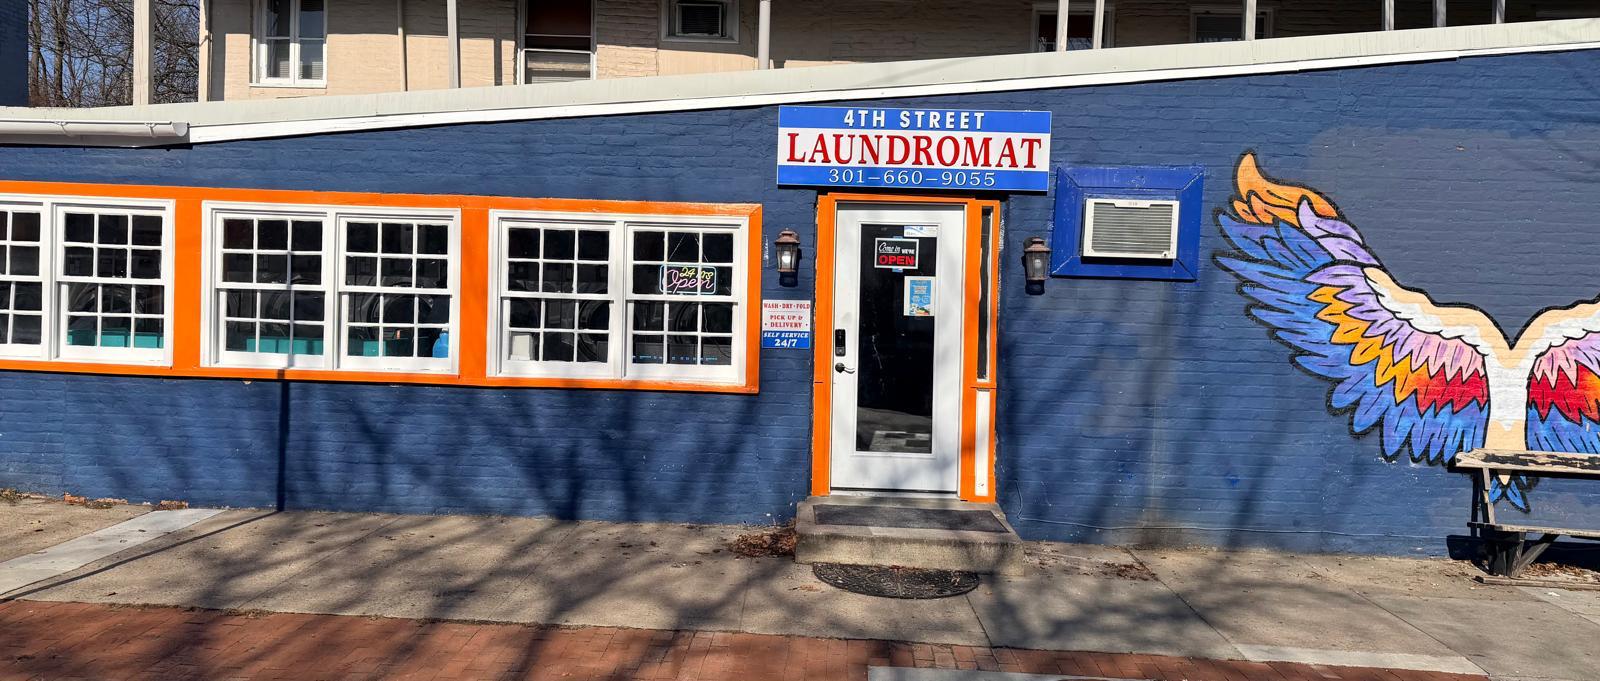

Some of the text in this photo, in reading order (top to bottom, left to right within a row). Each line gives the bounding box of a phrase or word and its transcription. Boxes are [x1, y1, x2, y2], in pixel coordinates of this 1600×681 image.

[843, 109, 985, 130] 4TH STREET
[786, 132, 1042, 169] LAUNDROMAT
[828, 168, 996, 187] 301-660-9055
[879, 255, 915, 265] OPEN
[662, 269, 714, 294] Open
[680, 266, 696, 278] 24
[774, 338, 798, 348] 24/7
